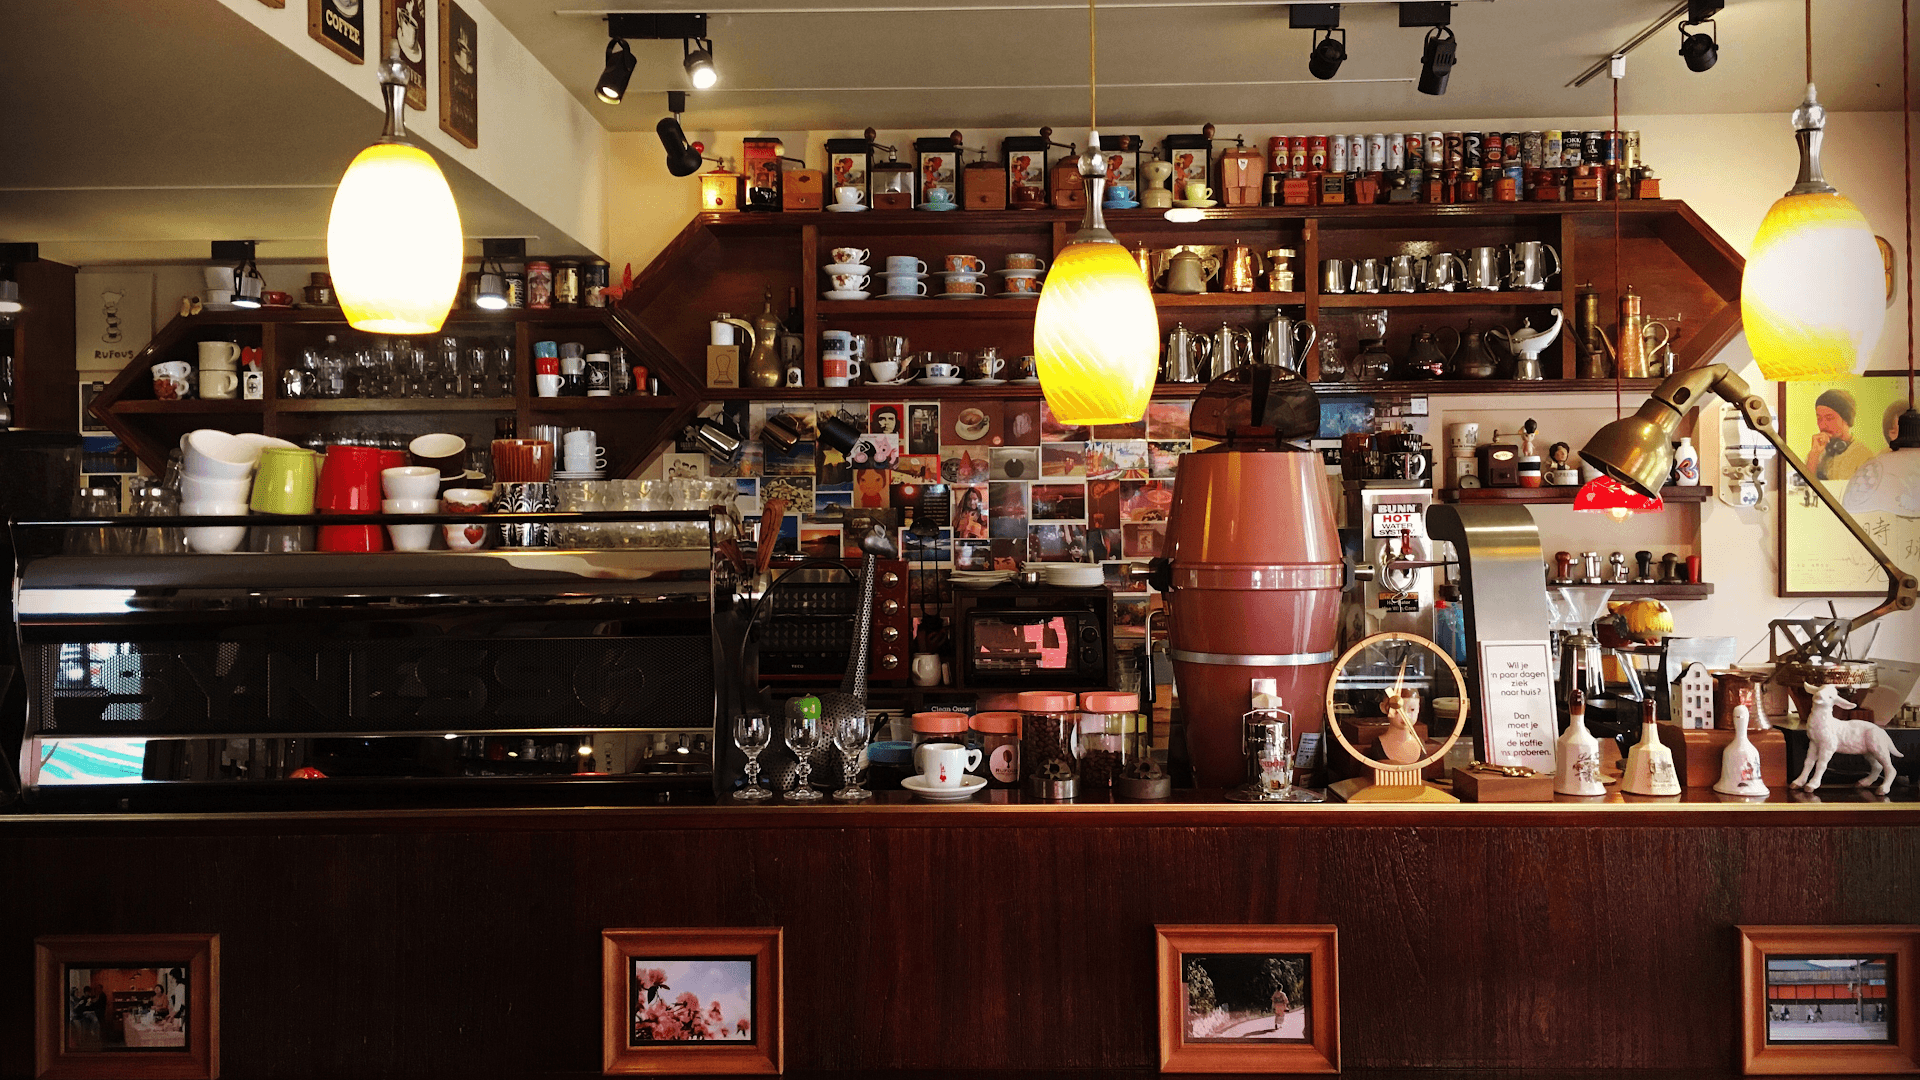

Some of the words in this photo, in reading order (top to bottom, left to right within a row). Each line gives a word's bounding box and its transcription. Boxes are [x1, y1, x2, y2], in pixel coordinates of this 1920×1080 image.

[325, 9, 361, 46] COFFEE
[1378, 504, 1416, 513] BUNN
[1383, 514, 1411, 523] HOT
[1521, 662, 1529, 670] je
[1499, 672, 1518, 680] paar
[1519, 671, 1546, 679] dagen
[1511, 679, 1528, 687] ziek
[1520, 688, 1542, 696] huis?
[1513, 712, 1530, 720] Dan
[1530, 721, 1539, 730] je
[1506, 739, 1517, 747] de
[1519, 739, 1543, 747] koffie
[1513, 749, 1552, 757] proberen.
